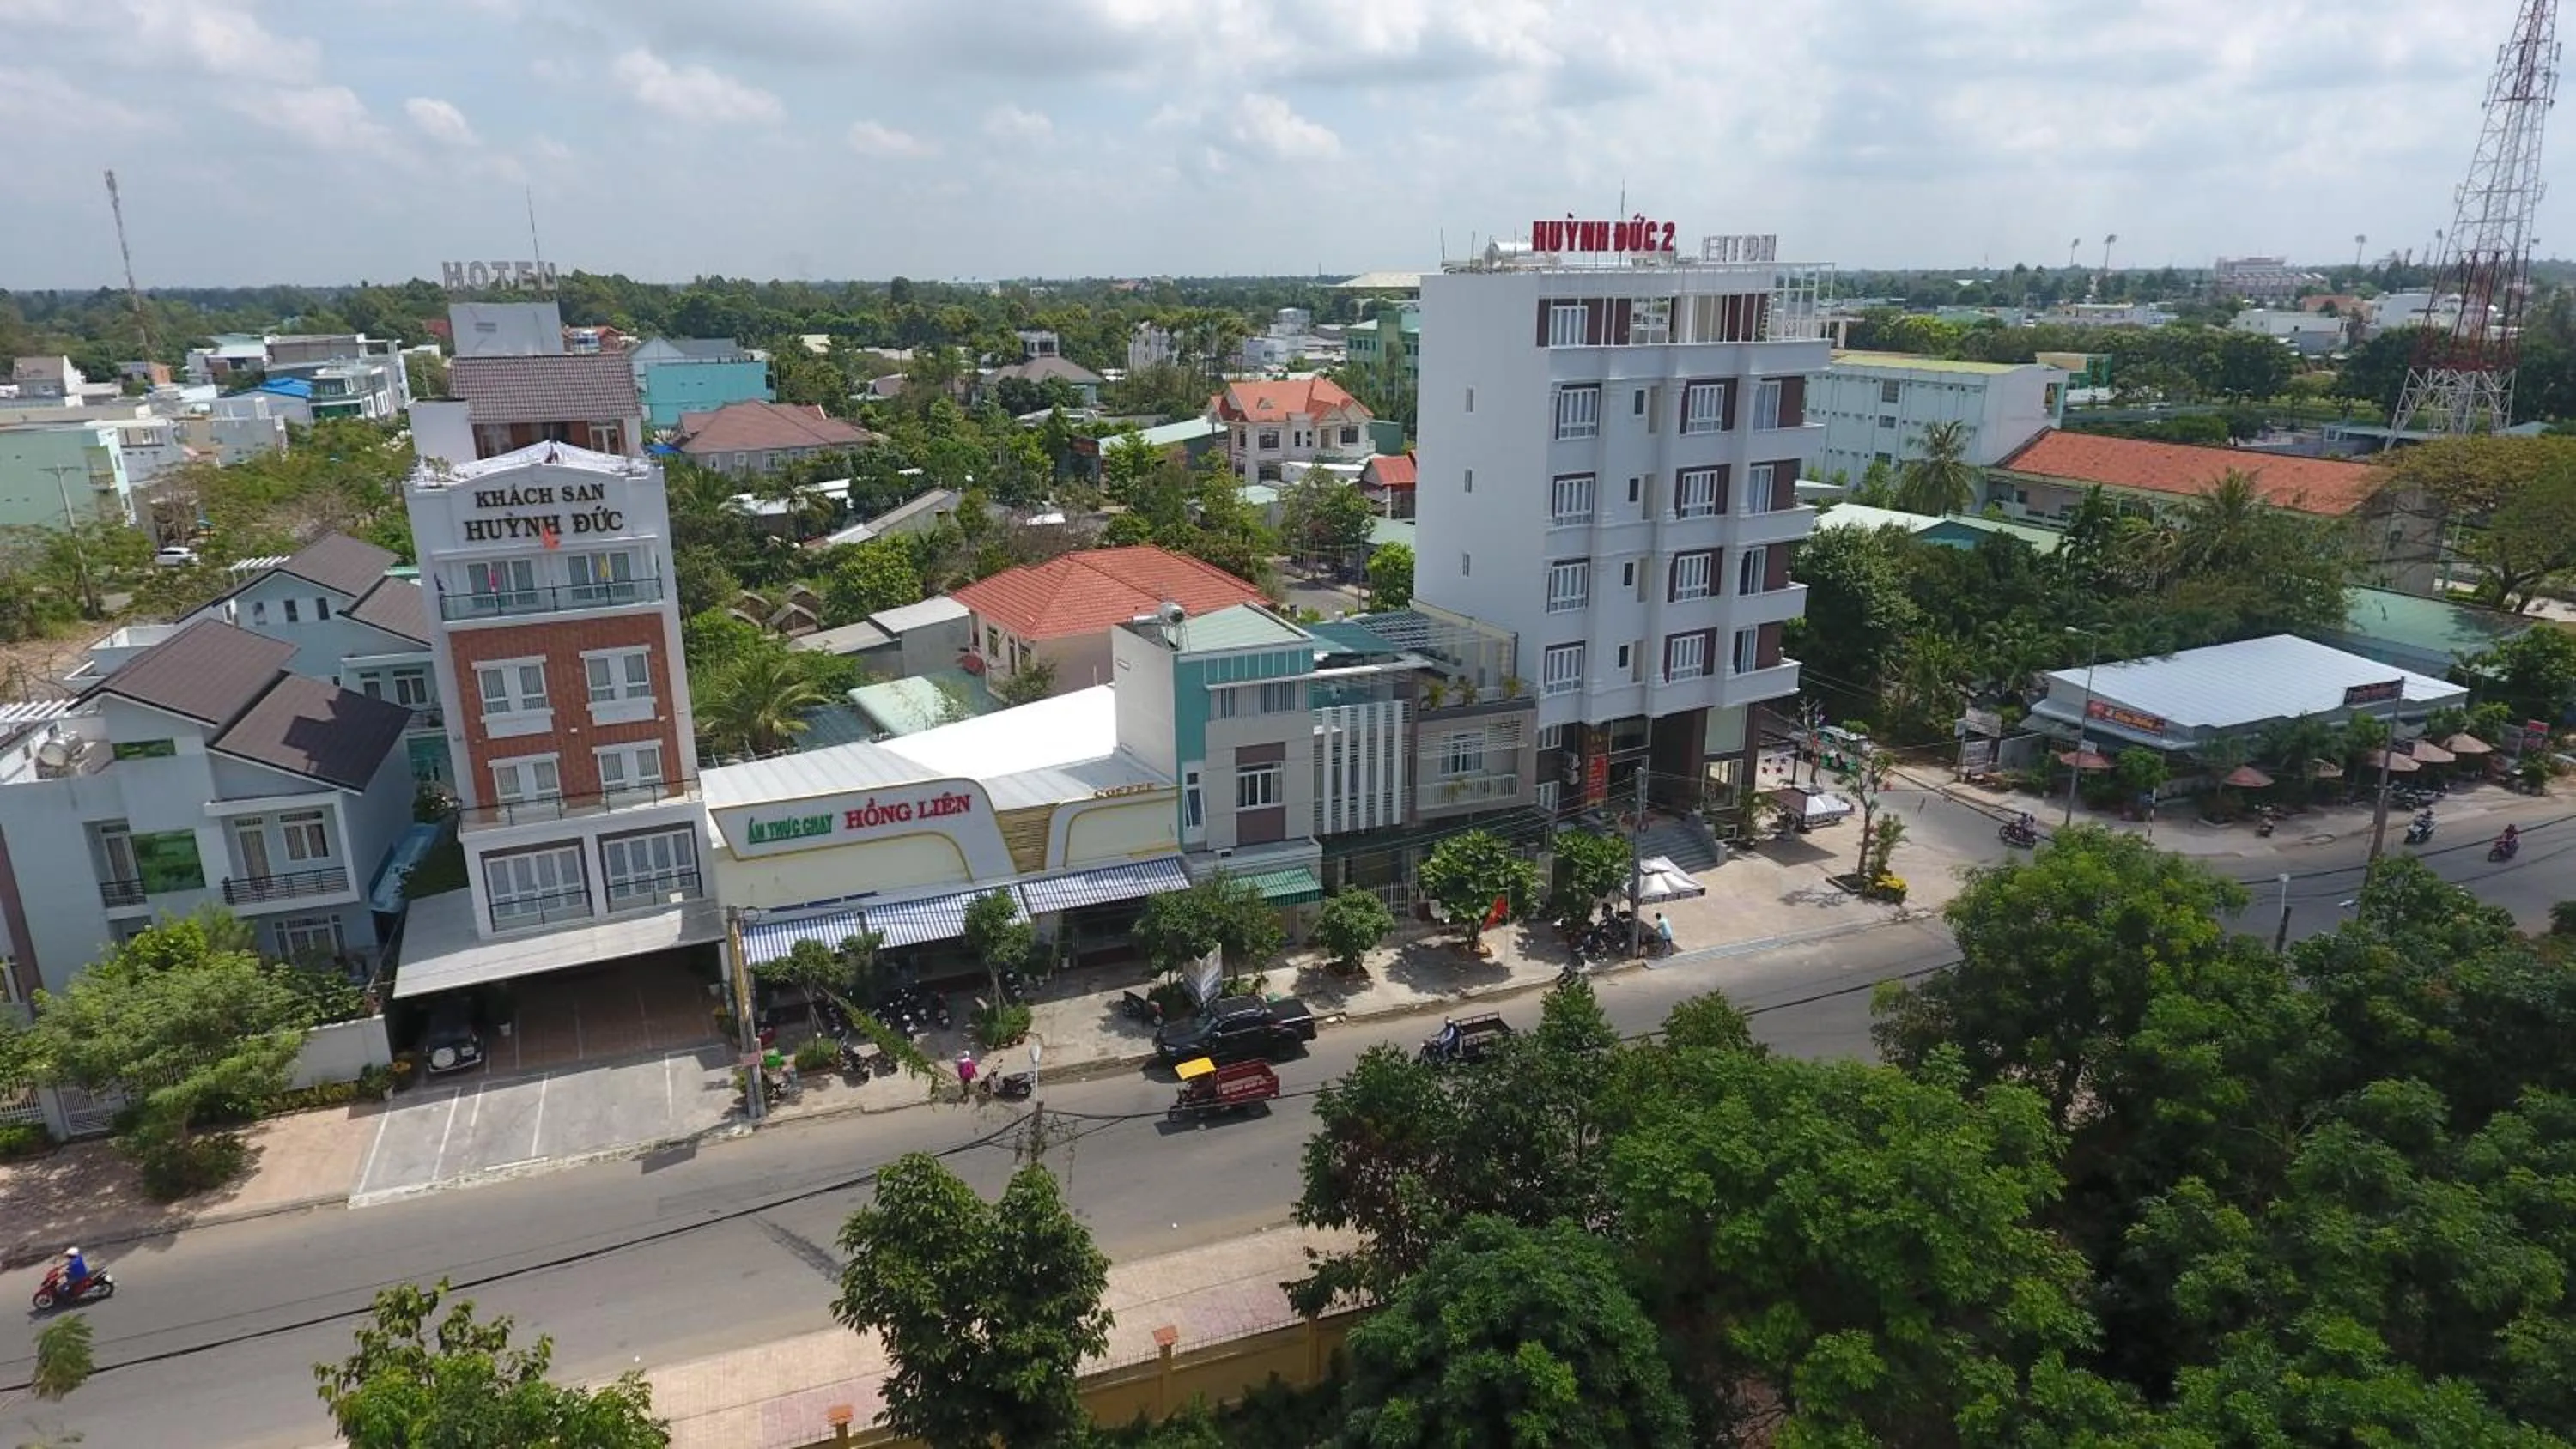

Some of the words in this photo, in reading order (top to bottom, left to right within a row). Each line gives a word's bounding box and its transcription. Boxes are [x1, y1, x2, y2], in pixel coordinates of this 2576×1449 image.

[1533, 213, 1609, 251] HUỲNH
[1614, 212, 1658, 251] ĐỨC
[1662, 221, 1675, 251] 2
[475, 484, 554, 508] KHÁCH
[562, 483, 605, 502] SAN
[465, 512, 562, 541] HUỲNH
[573, 506, 623, 533] ĐỨC
